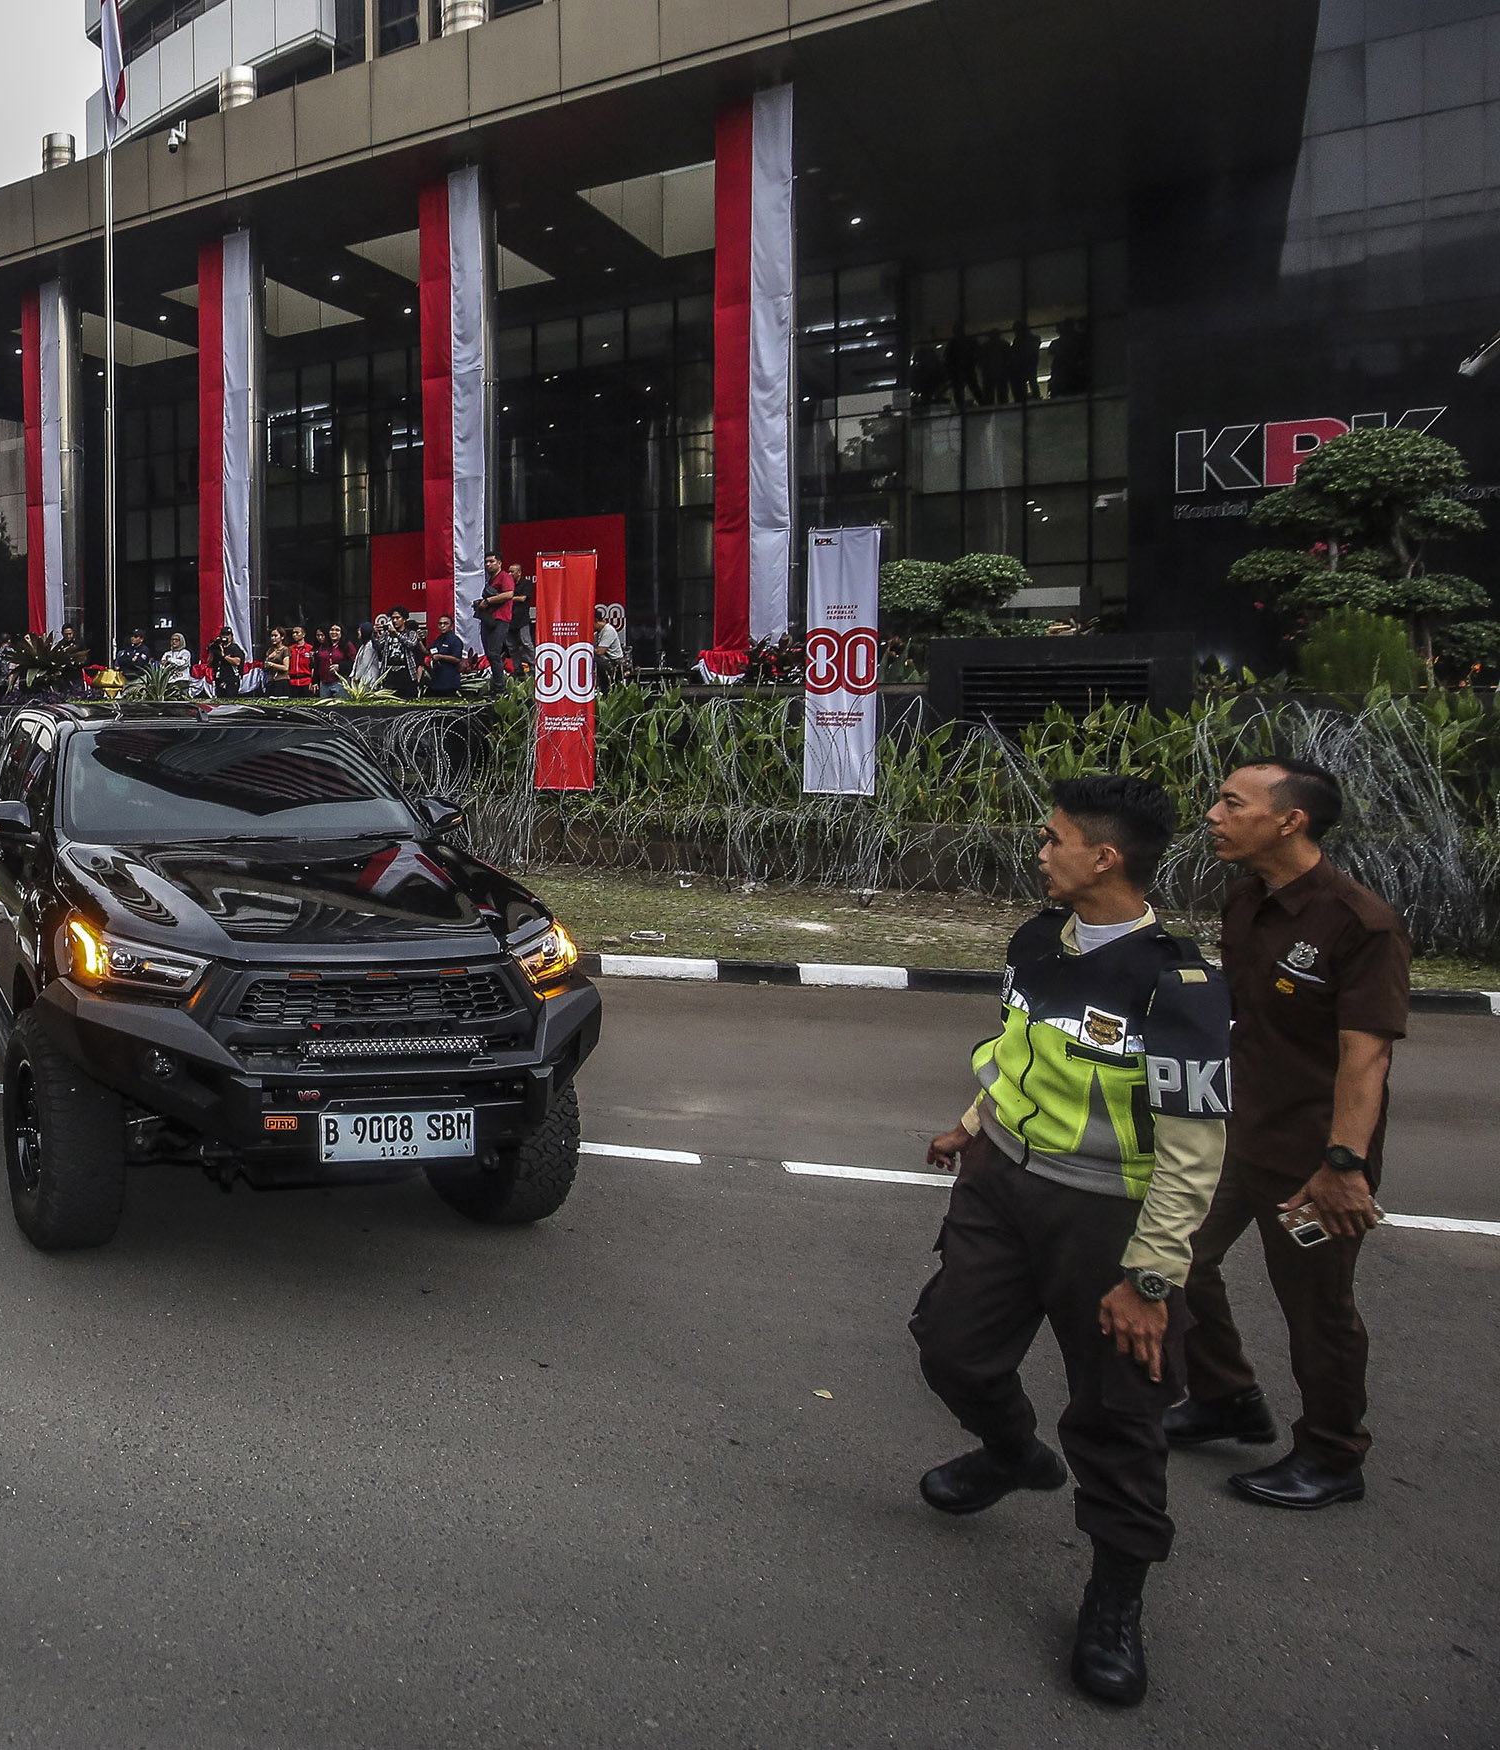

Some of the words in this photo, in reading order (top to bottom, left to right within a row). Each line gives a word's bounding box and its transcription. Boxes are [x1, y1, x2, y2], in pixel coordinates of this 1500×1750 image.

[1176, 406, 1448, 493] KP
[542, 560, 561, 568] KPK
[815, 537, 833, 546] KPK
[535, 642, 595, 703] 80
[806, 627, 878, 695] 80
[1146, 1054, 1233, 1113] PK
[324, 1118, 339, 1146] B
[352, 1114, 414, 1144] 9008
[427, 1112, 471, 1141] SBM
